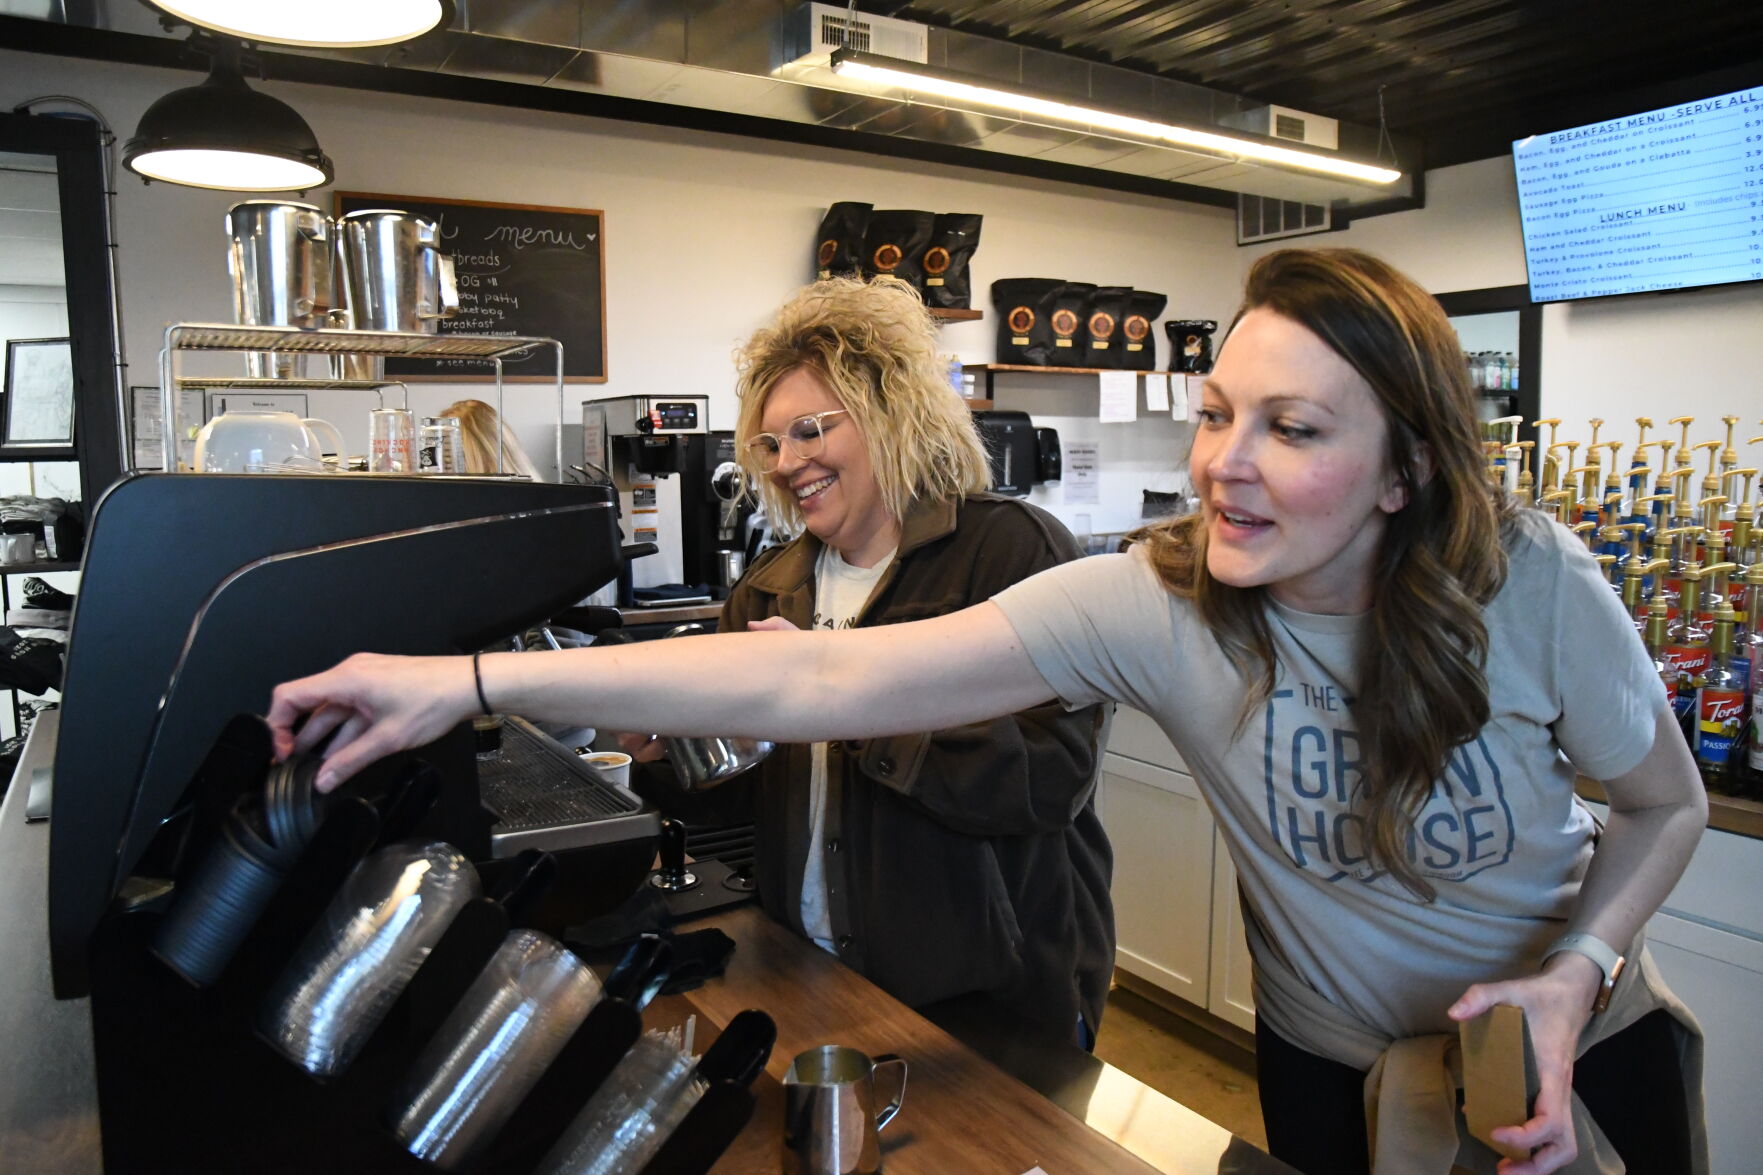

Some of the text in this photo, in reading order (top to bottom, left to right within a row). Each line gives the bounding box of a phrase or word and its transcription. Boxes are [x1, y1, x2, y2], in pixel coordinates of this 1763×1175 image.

[1550, 121, 1621, 144] BREAKFAST
[1627, 112, 1665, 127] MENU
[1729, 92, 1756, 107] ALL
[1565, 156, 1581, 164] and
[1584, 149, 1622, 160] Cheddar
[1648, 133, 1696, 148] Croissant
[1744, 119, 1763, 129] 6.9
[1571, 141, 1588, 150] and
[1590, 133, 1629, 145] Cheddar
[1647, 119, 1695, 134] Croissant
[1574, 167, 1590, 176] and
[1592, 161, 1622, 172] Gouda
[1625, 159, 1637, 167] on
[1649, 149, 1691, 161] Ciabatta
[1745, 134, 1763, 143] 6.9
[1523, 187, 1558, 197] Avocado
[1561, 182, 1585, 191] Toast
[1525, 200, 1558, 210] Sausage
[1581, 192, 1604, 200] Pizza
[1526, 214, 1551, 222] Bacon
[1554, 210, 1570, 218] Egg
[1573, 207, 1596, 215] Pizza
[1600, 209, 1642, 223] LUNCH
[1648, 202, 1686, 215] MENU
[484, 225, 585, 250] menu
[1528, 231, 1561, 240] Chicken
[1564, 226, 1588, 235] Salad
[1590, 220, 1633, 231] Croissant
[1568, 238, 1605, 247] Cheddar
[1608, 231, 1651, 242] Croissant
[1531, 257, 1559, 265] Turkey
[1617, 243, 1661, 254] Croissant
[1606, 259, 1644, 269] Cheddar
[1647, 252, 1693, 264] Croissant
[1534, 281, 1559, 289] Monte
[1590, 273, 1633, 284] Croissant
[1650, 281, 1683, 289] Cheese
[485, 293, 519, 309] patty
[442, 319, 495, 329] breakfast
[1299, 683, 1338, 712] THE
[1706, 699, 1744, 723] Tora
[1291, 725, 1482, 802] GRN
